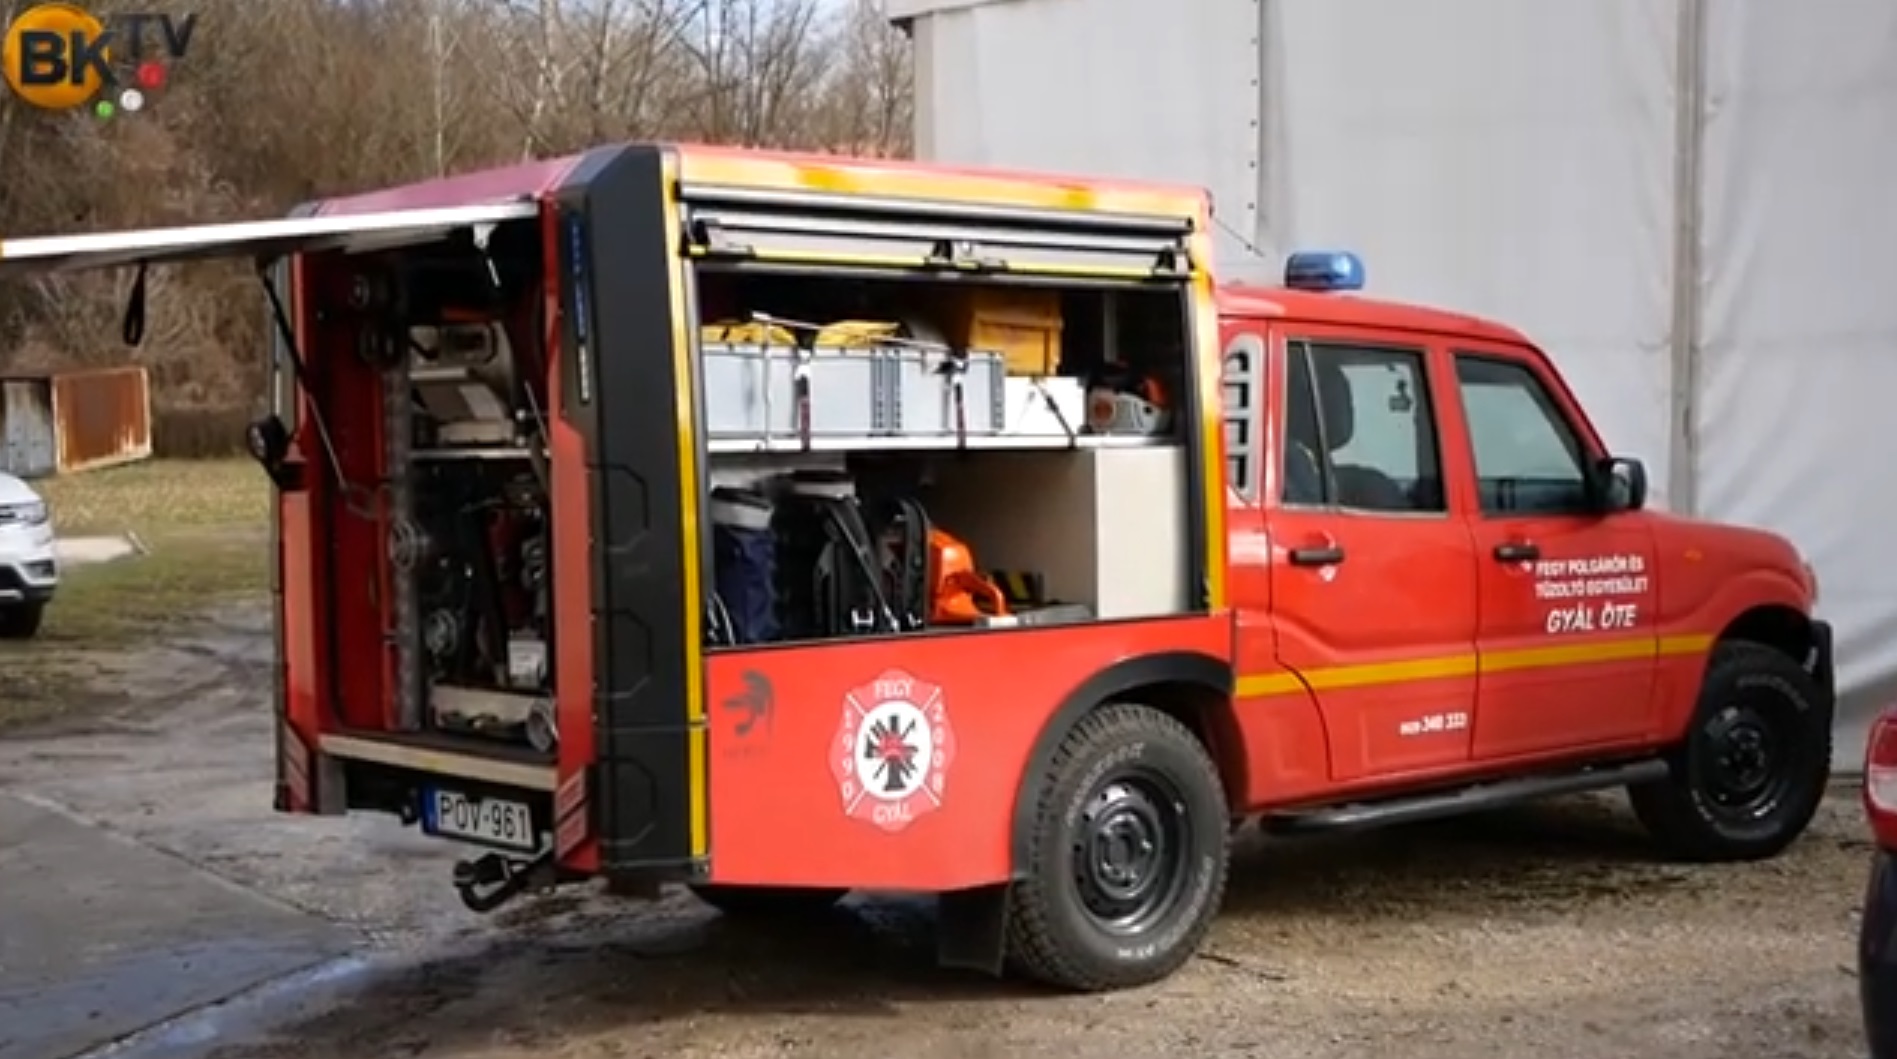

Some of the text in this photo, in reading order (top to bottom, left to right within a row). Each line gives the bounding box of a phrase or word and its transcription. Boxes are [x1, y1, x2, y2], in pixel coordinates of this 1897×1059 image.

[1547, 602, 1595, 634] GYÁL
[873, 678, 914, 699] FEGY
[440, 794, 527, 840] POV-961
